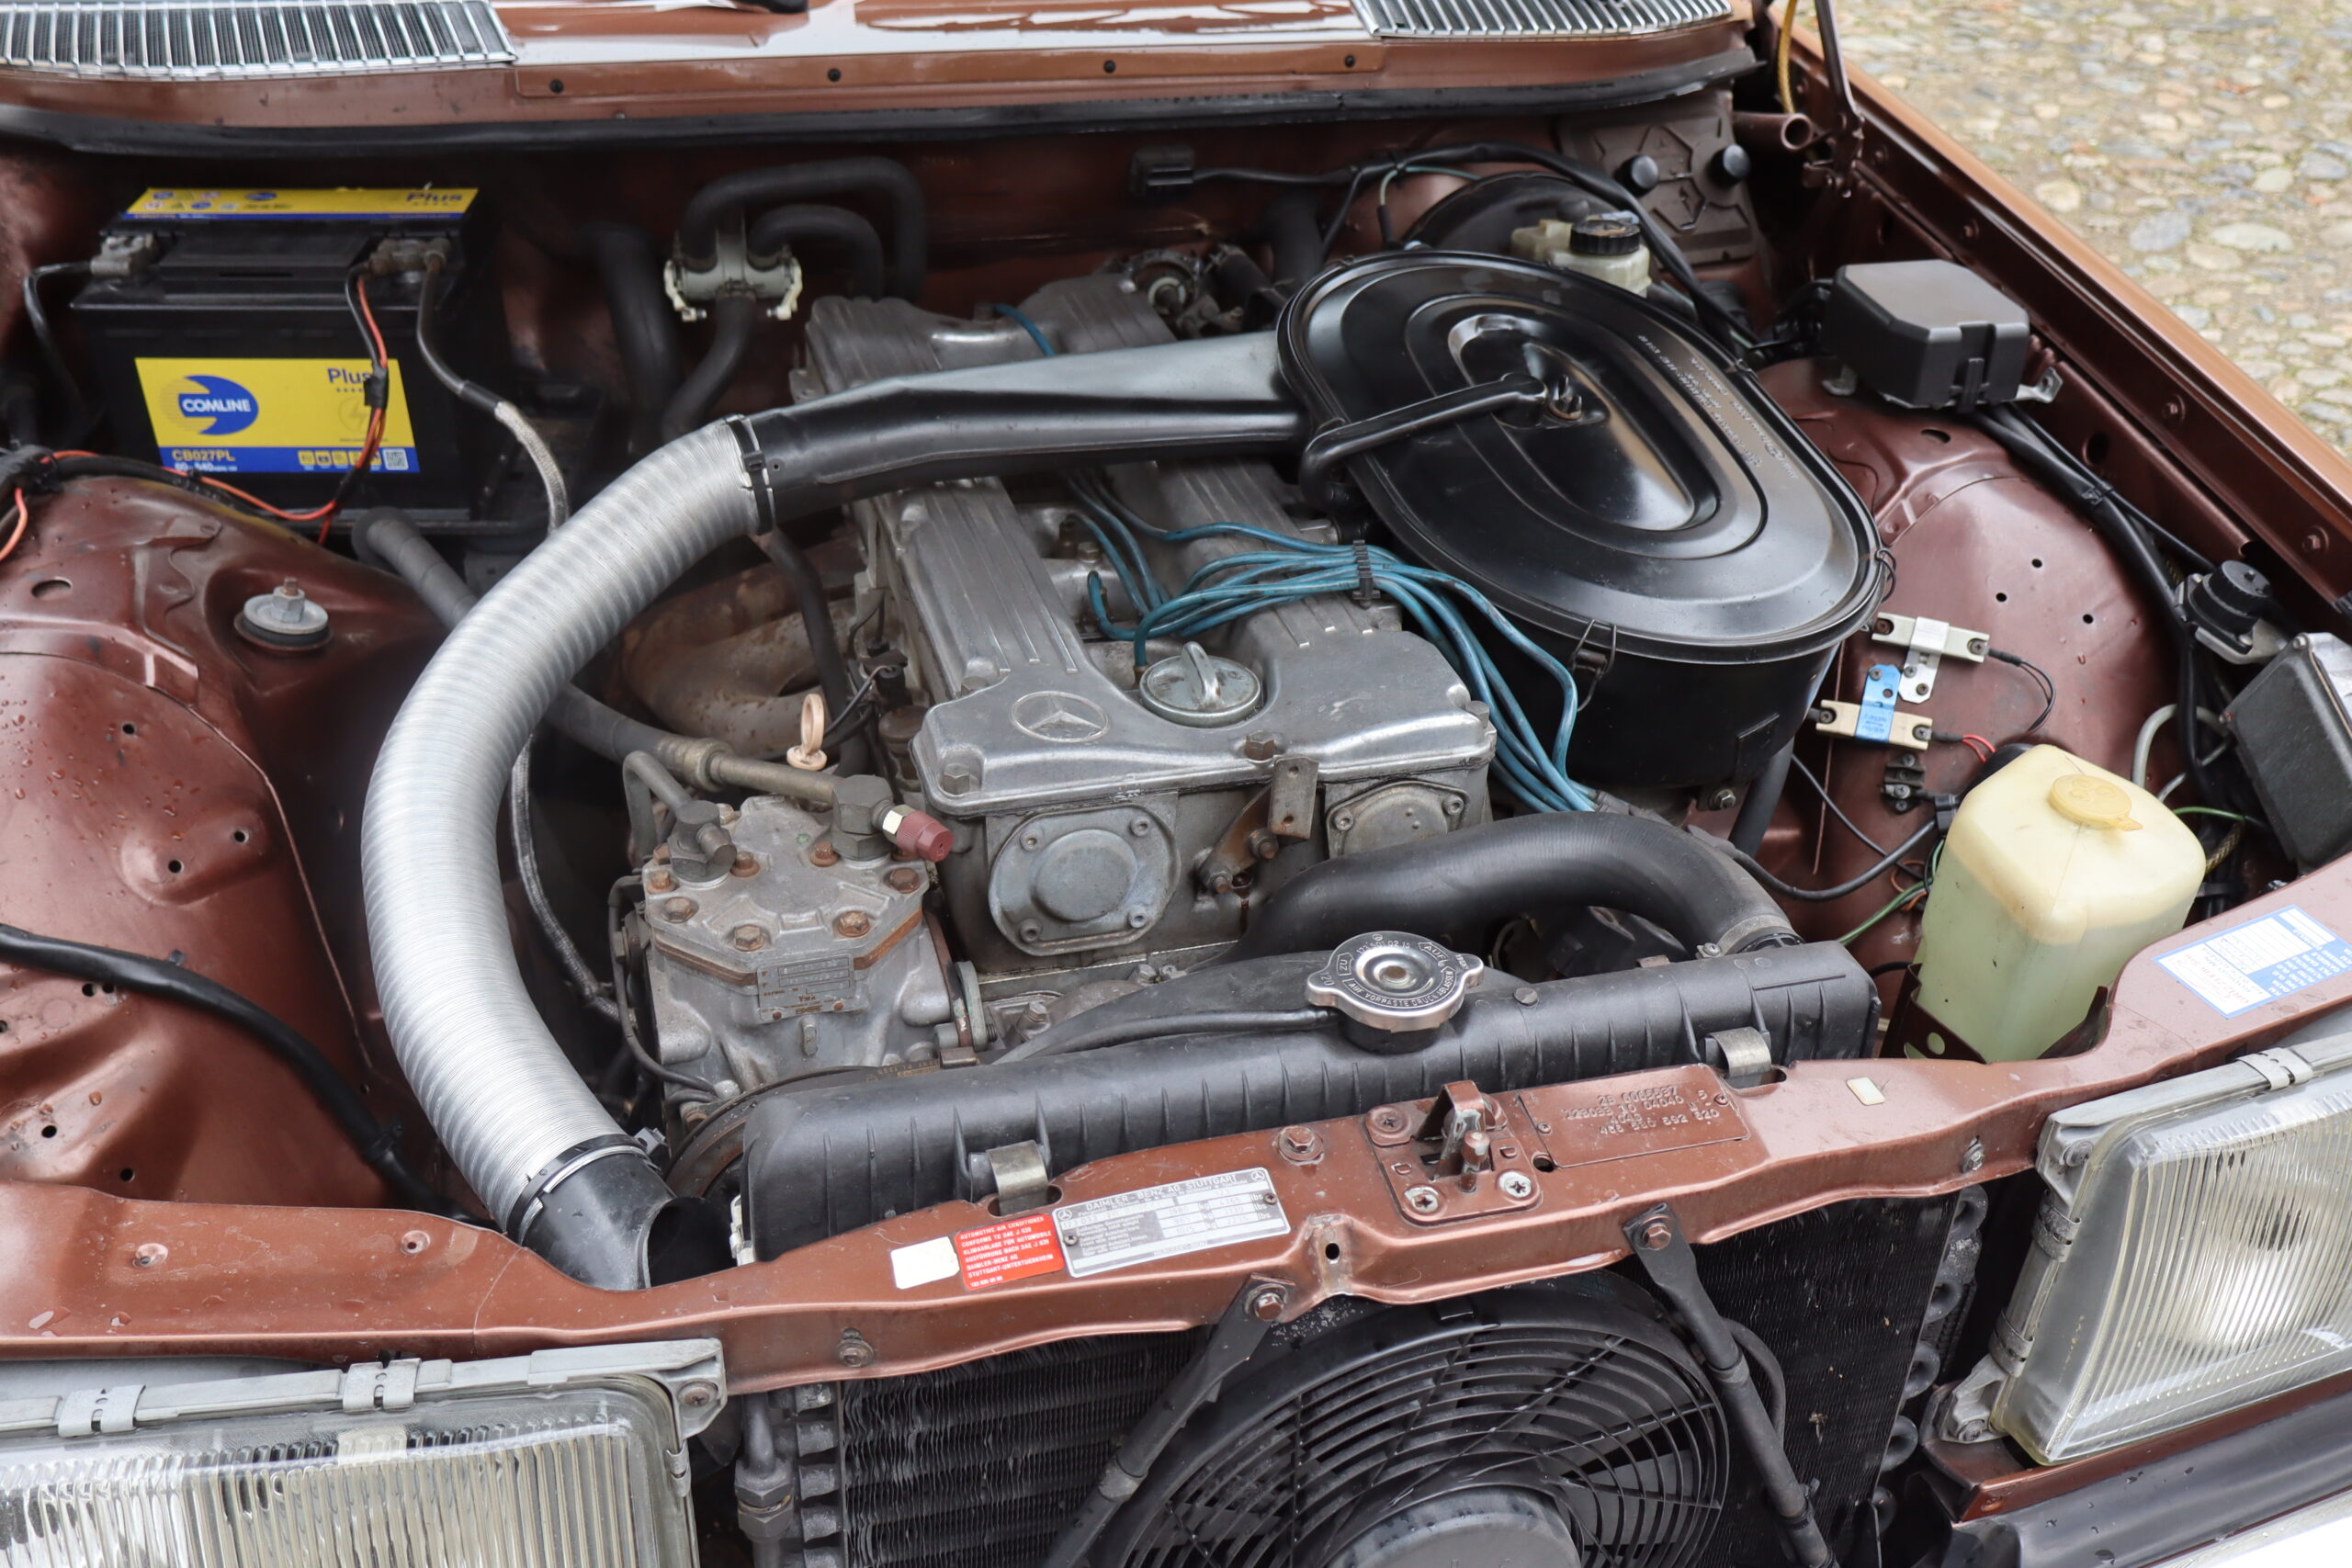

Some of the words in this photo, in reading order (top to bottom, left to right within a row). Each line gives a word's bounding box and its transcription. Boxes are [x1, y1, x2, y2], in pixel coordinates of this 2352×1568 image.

[182, 398, 252, 413] COMLINE
[1423, 945, 1445, 961] AUF
[1339, 959, 1348, 971] ZU
[1319, 972, 1335, 986] 120
[1349, 982, 1364, 994] AUF
[1085, 1195, 1128, 1210] DAIMLER
[1136, 1188, 1163, 1199] BENZ
[1185, 1174, 1237, 1190] STUTTGART
[1250, 1192, 1262, 1201] lbs
[959, 1226, 994, 1239] AUTOMOTIVE
[1008, 1216, 1044, 1228] CONDITIONER
[961, 1235, 991, 1247] CONFORMS
[963, 1241, 1001, 1255] KLIMAANLAGE
[1016, 1230, 1051, 1243] AUTOMOBILE
[965, 1248, 1001, 1262] AUSFÜHRUNG
[1003, 1245, 1019, 1253] NACH
[967, 1256, 1008, 1269] DAIMLER-BENZ
